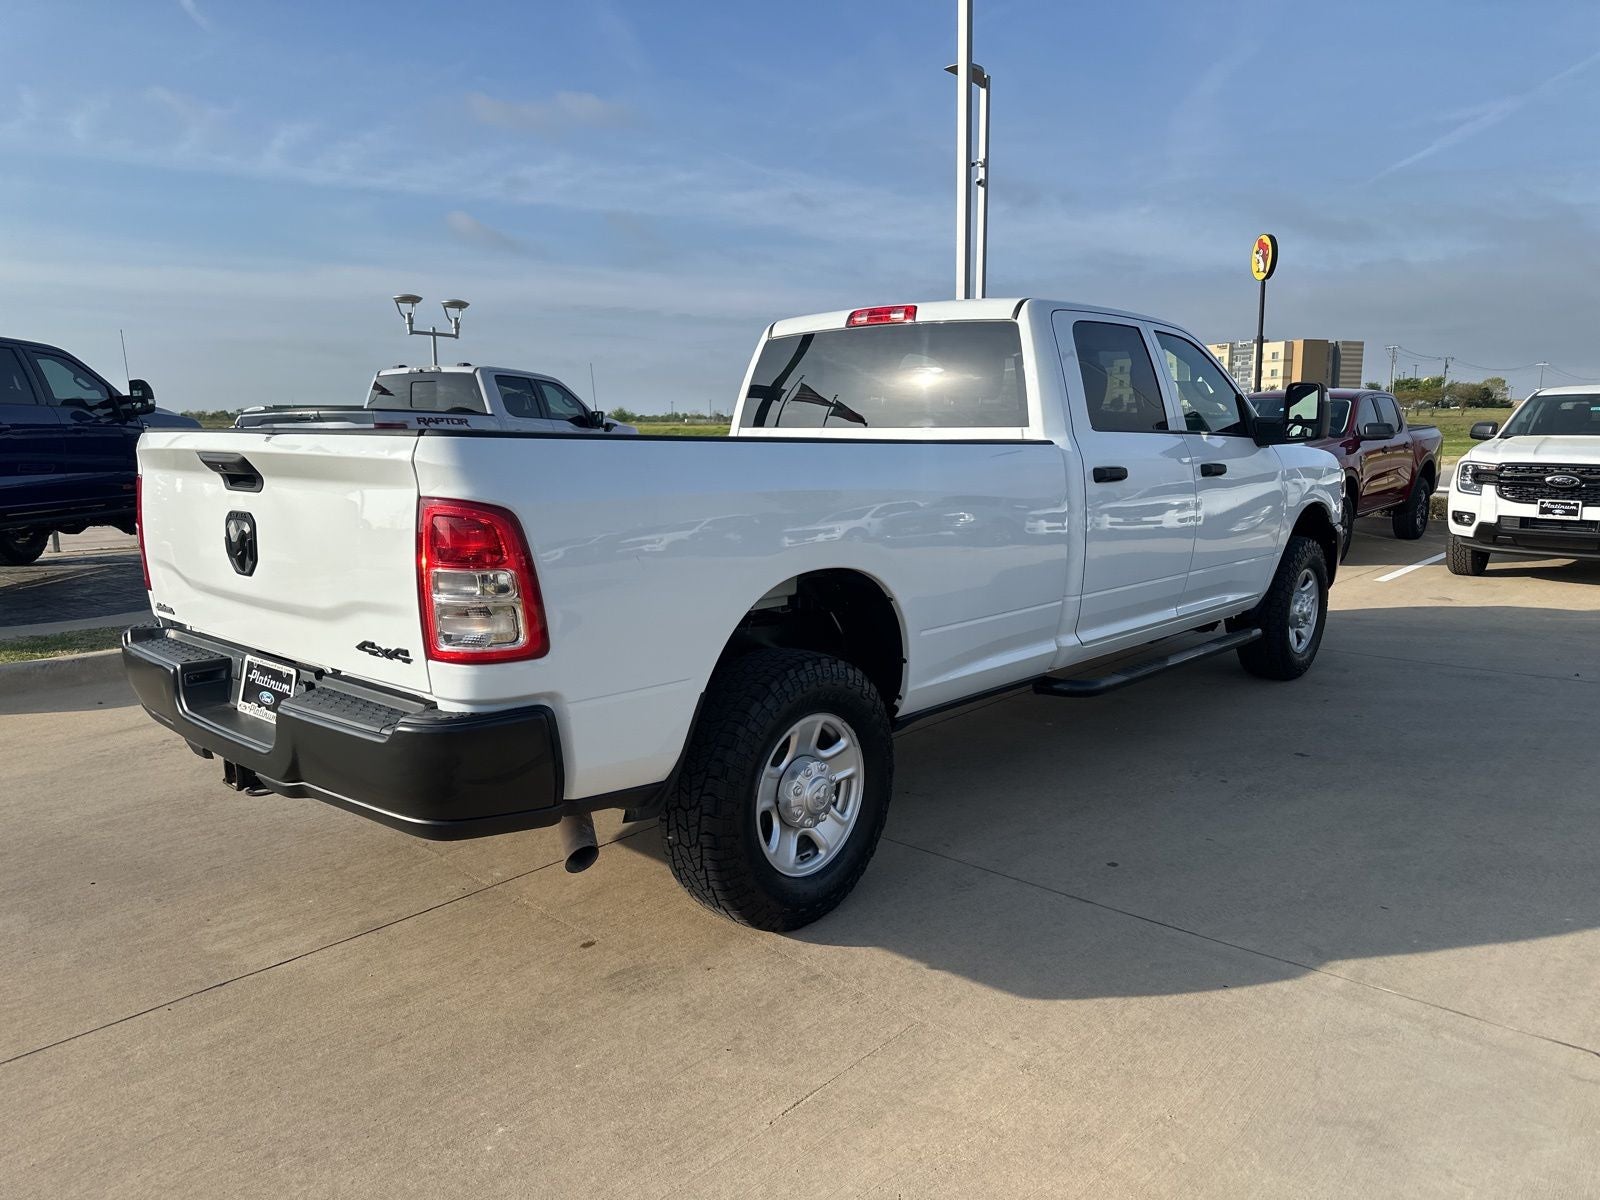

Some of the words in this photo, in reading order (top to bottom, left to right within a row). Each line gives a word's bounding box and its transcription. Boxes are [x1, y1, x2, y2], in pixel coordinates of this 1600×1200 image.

[416, 417, 472, 429] RAPTOR
[1541, 502, 1578, 510] Platinum
[248, 669, 291, 694] Platinum
